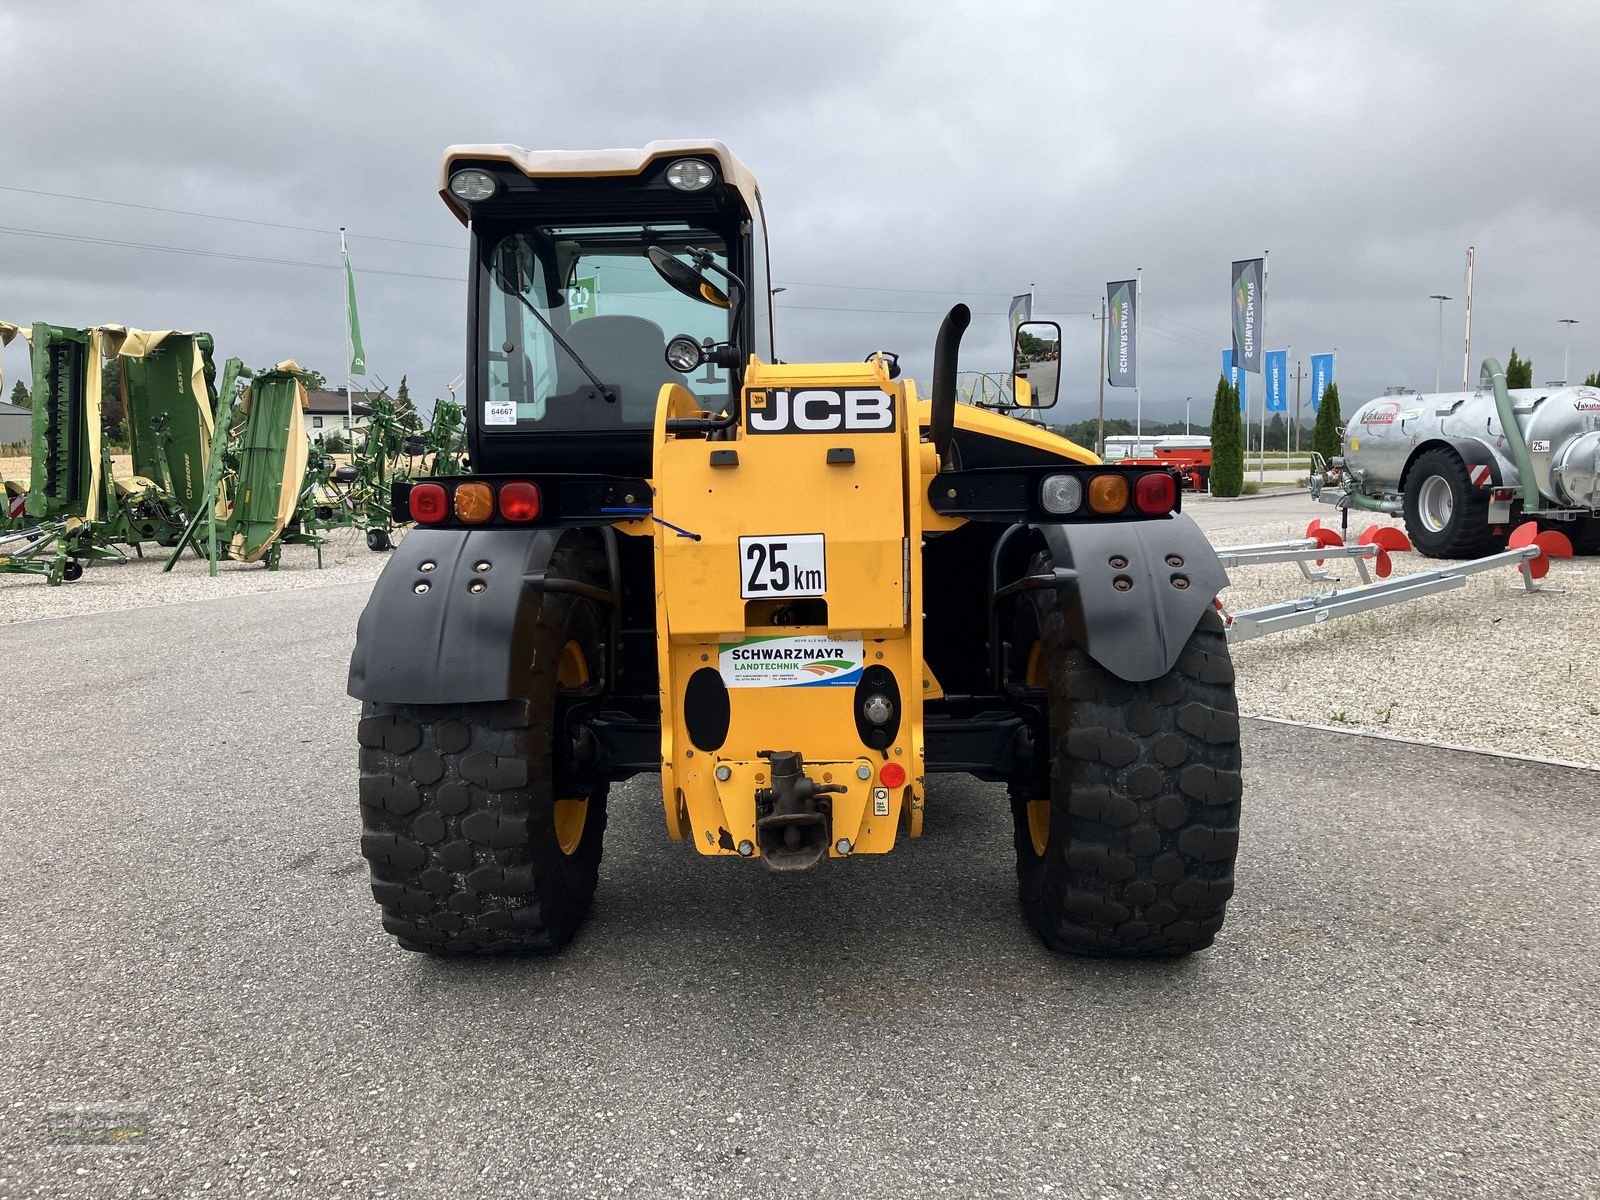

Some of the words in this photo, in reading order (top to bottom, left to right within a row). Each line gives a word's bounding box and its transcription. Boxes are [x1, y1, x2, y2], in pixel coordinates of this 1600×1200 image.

[750, 390, 893, 431] JCB
[1533, 441, 1543, 451] 25
[746, 543, 790, 592] 25
[794, 564, 822, 591] km
[732, 648, 844, 661] SCHWARZMAYR
[734, 662, 799, 671] LANDTECHNIK
